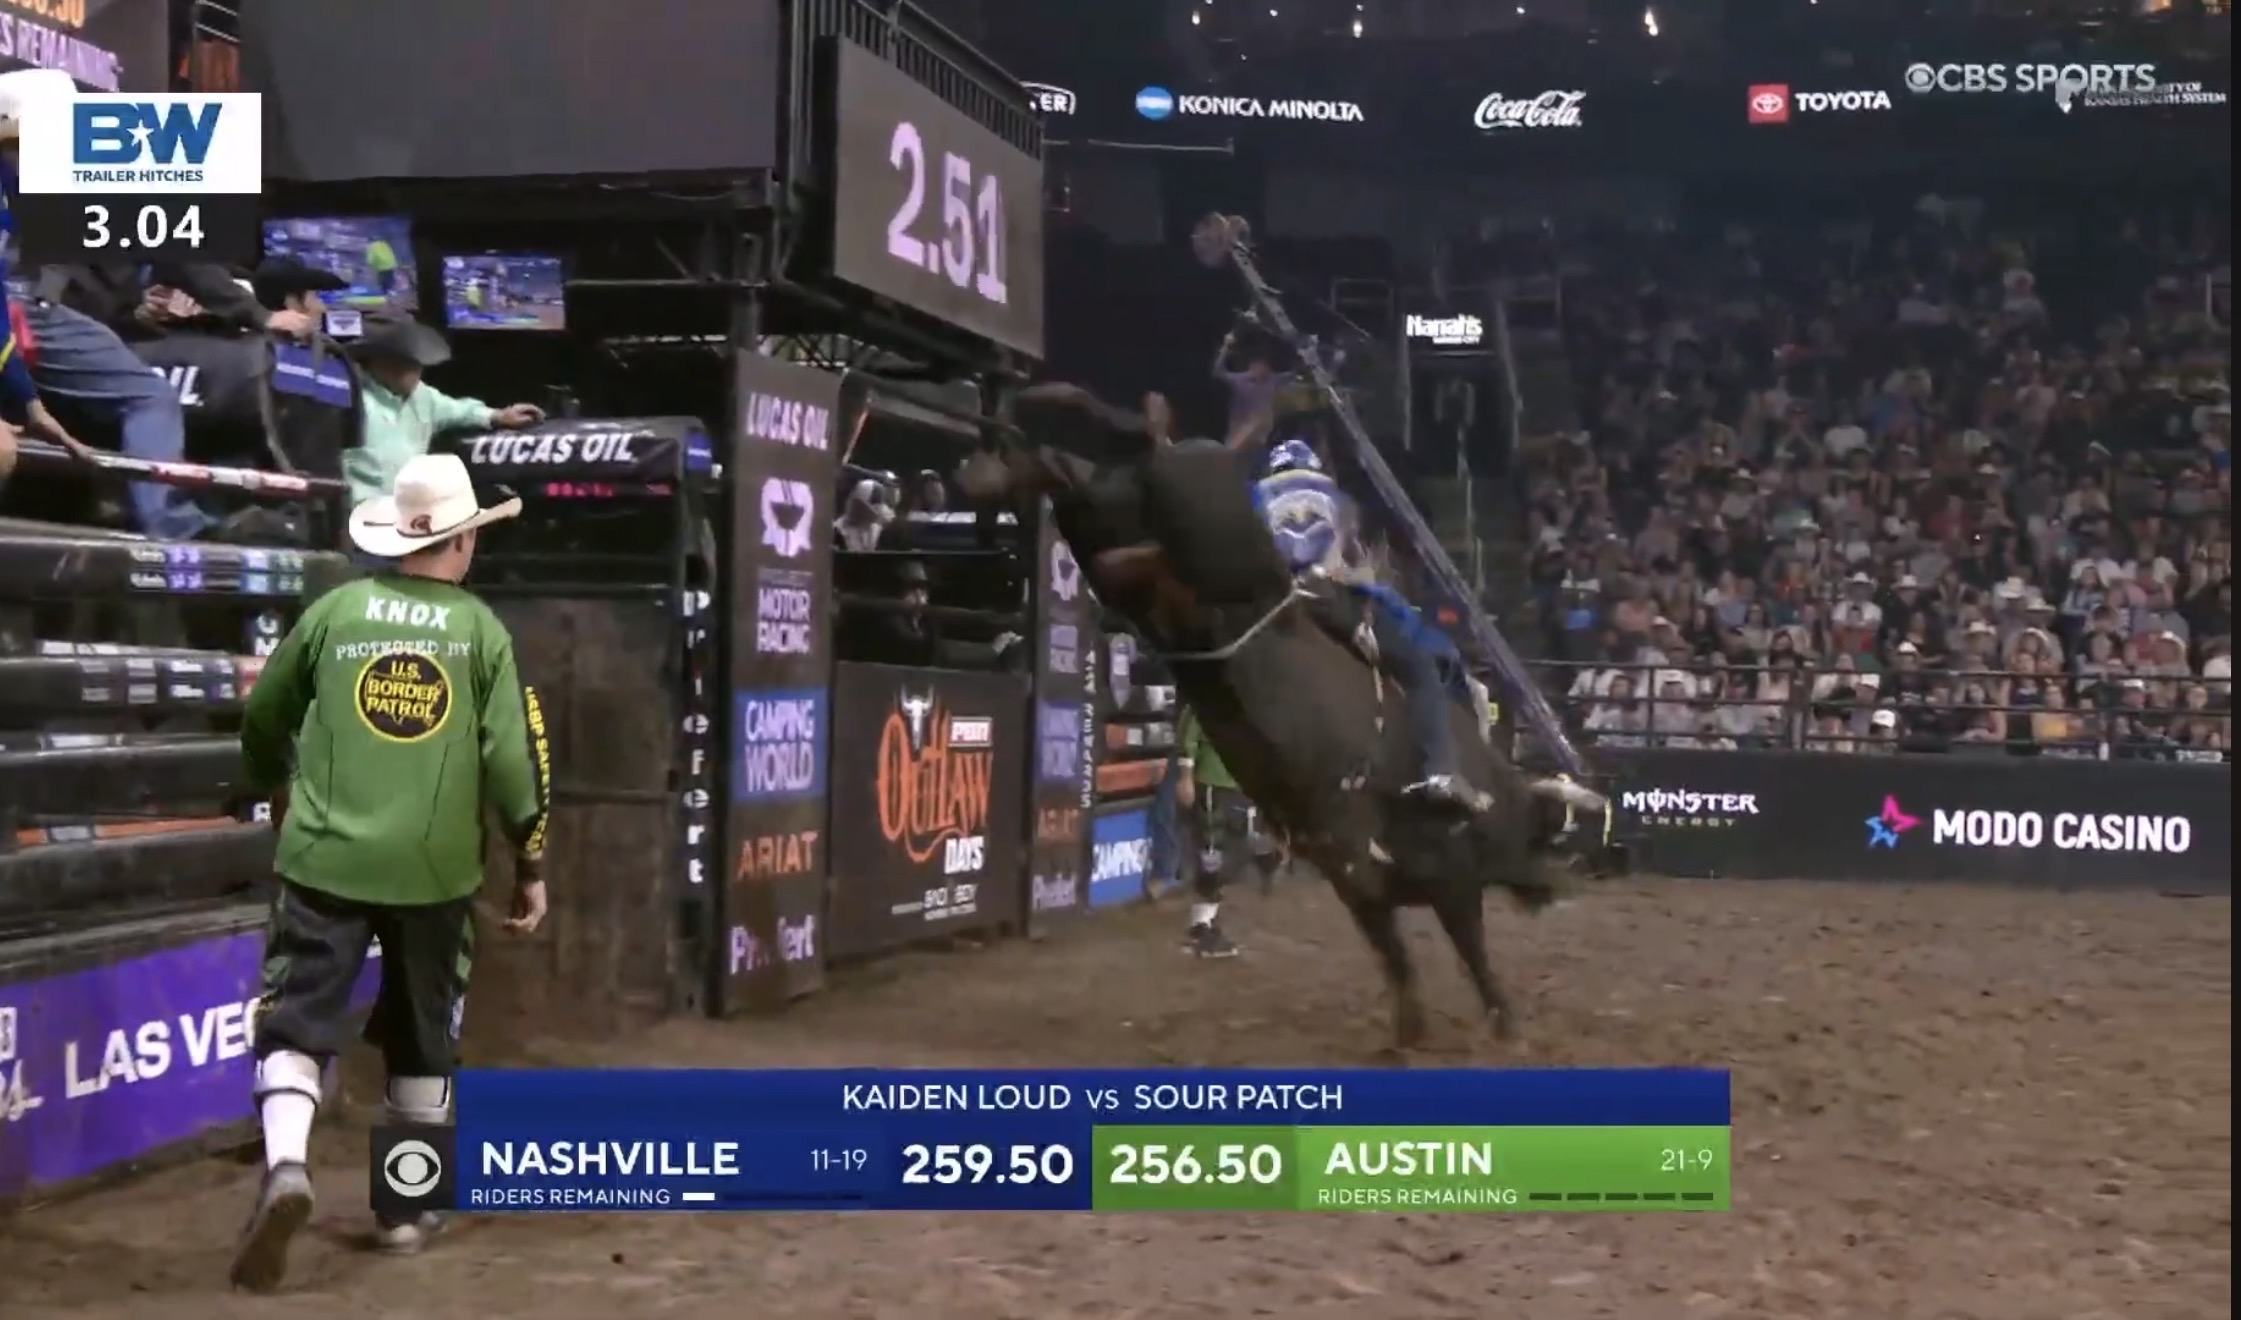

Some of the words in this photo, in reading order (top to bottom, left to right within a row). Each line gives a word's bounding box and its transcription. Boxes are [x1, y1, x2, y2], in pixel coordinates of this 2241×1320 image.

[1178, 95, 1265, 117] KONICA
[1268, 100, 1364, 122] MINOLTA
[1795, 91, 1891, 112] TOYOTA
[887, 121, 1007, 303] 2.51
[746, 392, 803, 445] LUCAS
[803, 404, 829, 450] OIL
[471, 433, 575, 464] LUCAS
[582, 432, 638, 463] OIL
[364, 596, 451, 631] KNOX
[758, 588, 811, 622] MOTOR
[335, 638, 439, 661] PROTECTED
[447, 641, 472, 657] BY
[757, 622, 811, 654] RACING
[390, 660, 422, 680] U.S.
[368, 678, 440, 701] BORDER
[365, 697, 436, 719] PATROL
[744, 699, 815, 743] CAMPING
[744, 743, 815, 793] WORLD
[1622, 790, 1760, 815] MONSTER
[1932, 808, 2044, 848] MODO
[2053, 811, 2191, 853] CASINO
[736, 829, 819, 883] ARIAT
[944, 836, 986, 875] DAYS
[65, 1020, 173, 1099] LAS
[179, 996, 262, 1067] VE
